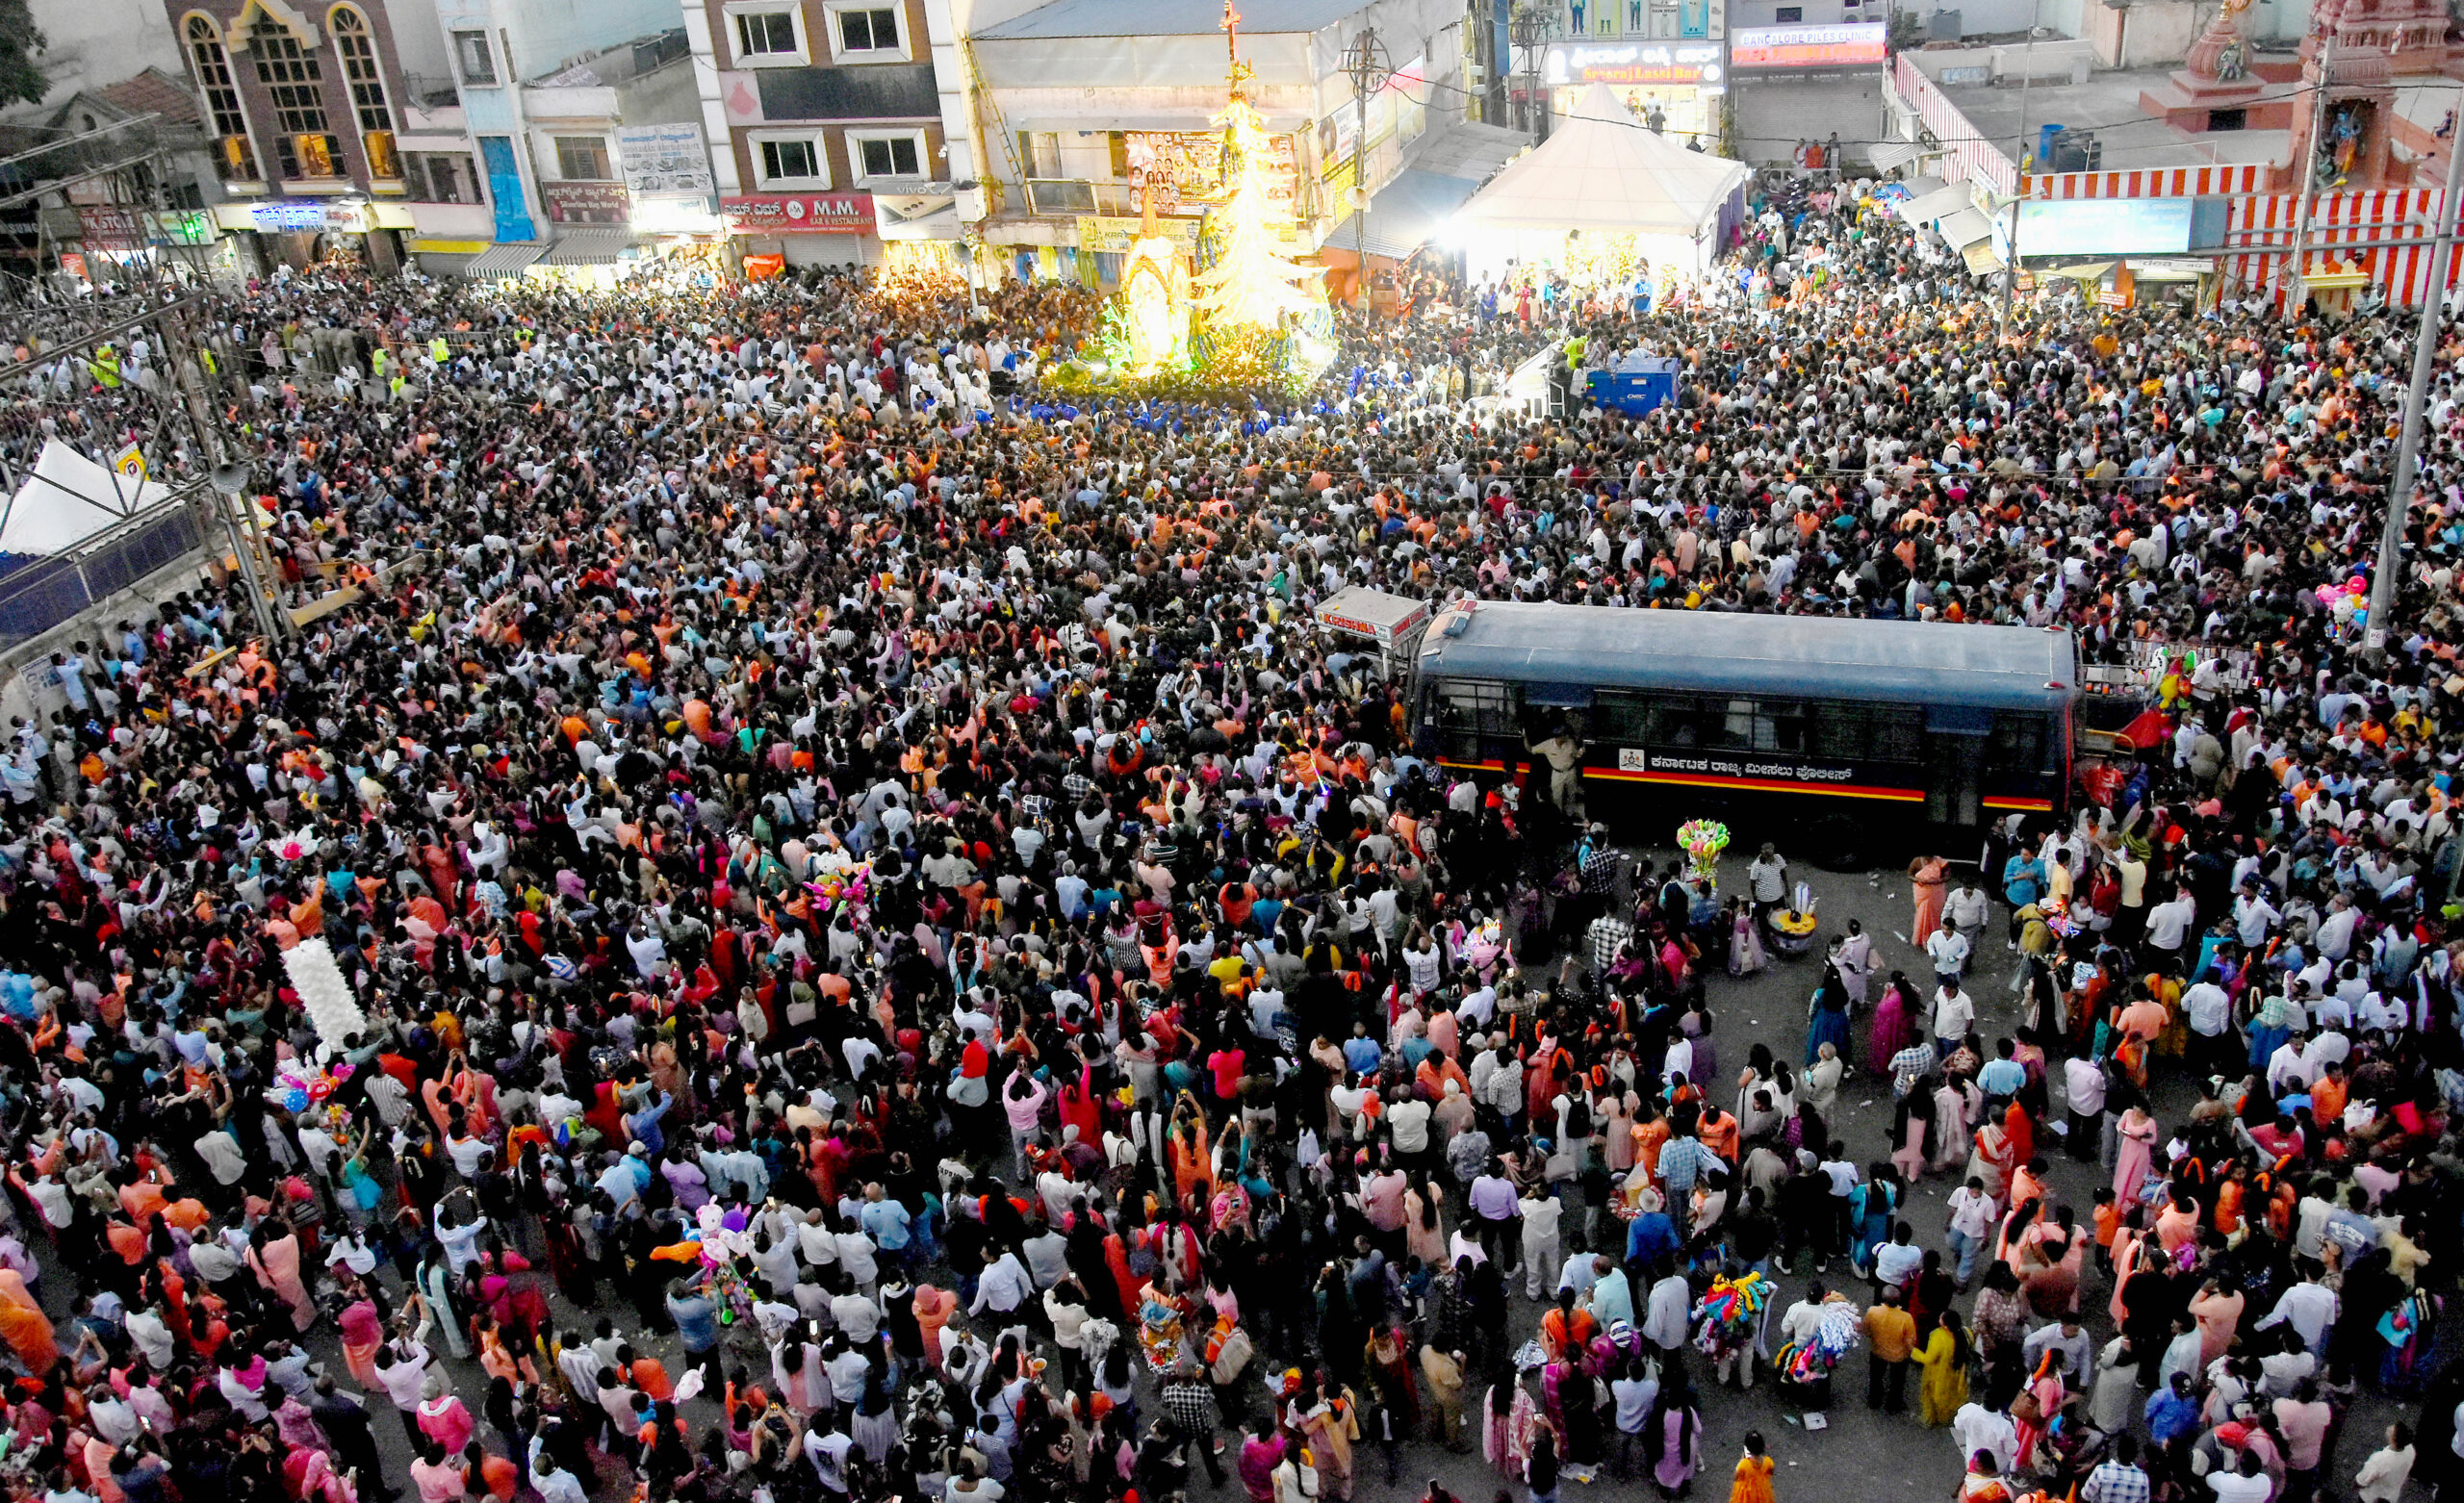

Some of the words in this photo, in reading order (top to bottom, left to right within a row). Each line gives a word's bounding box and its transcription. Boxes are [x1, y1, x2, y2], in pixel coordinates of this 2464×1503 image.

[1743, 34, 1805, 45] BANGALORE
[1808, 32, 1835, 42] PILES
[1838, 30, 1872, 41] CLINIC
[1635, 66, 1672, 79] Lassi
[1674, 66, 1701, 79] Bar
[897, 186, 927, 194] vivo
[813, 200, 860, 216] M.M.
[1323, 613, 1376, 636] KRISHNA
[1651, 754, 1708, 771] ಕರ್ನಾಟಕ
[1711, 761, 1742, 777] ರಾಜ್ಯ
[1745, 763, 1793, 777] ಮೀಸಲು
